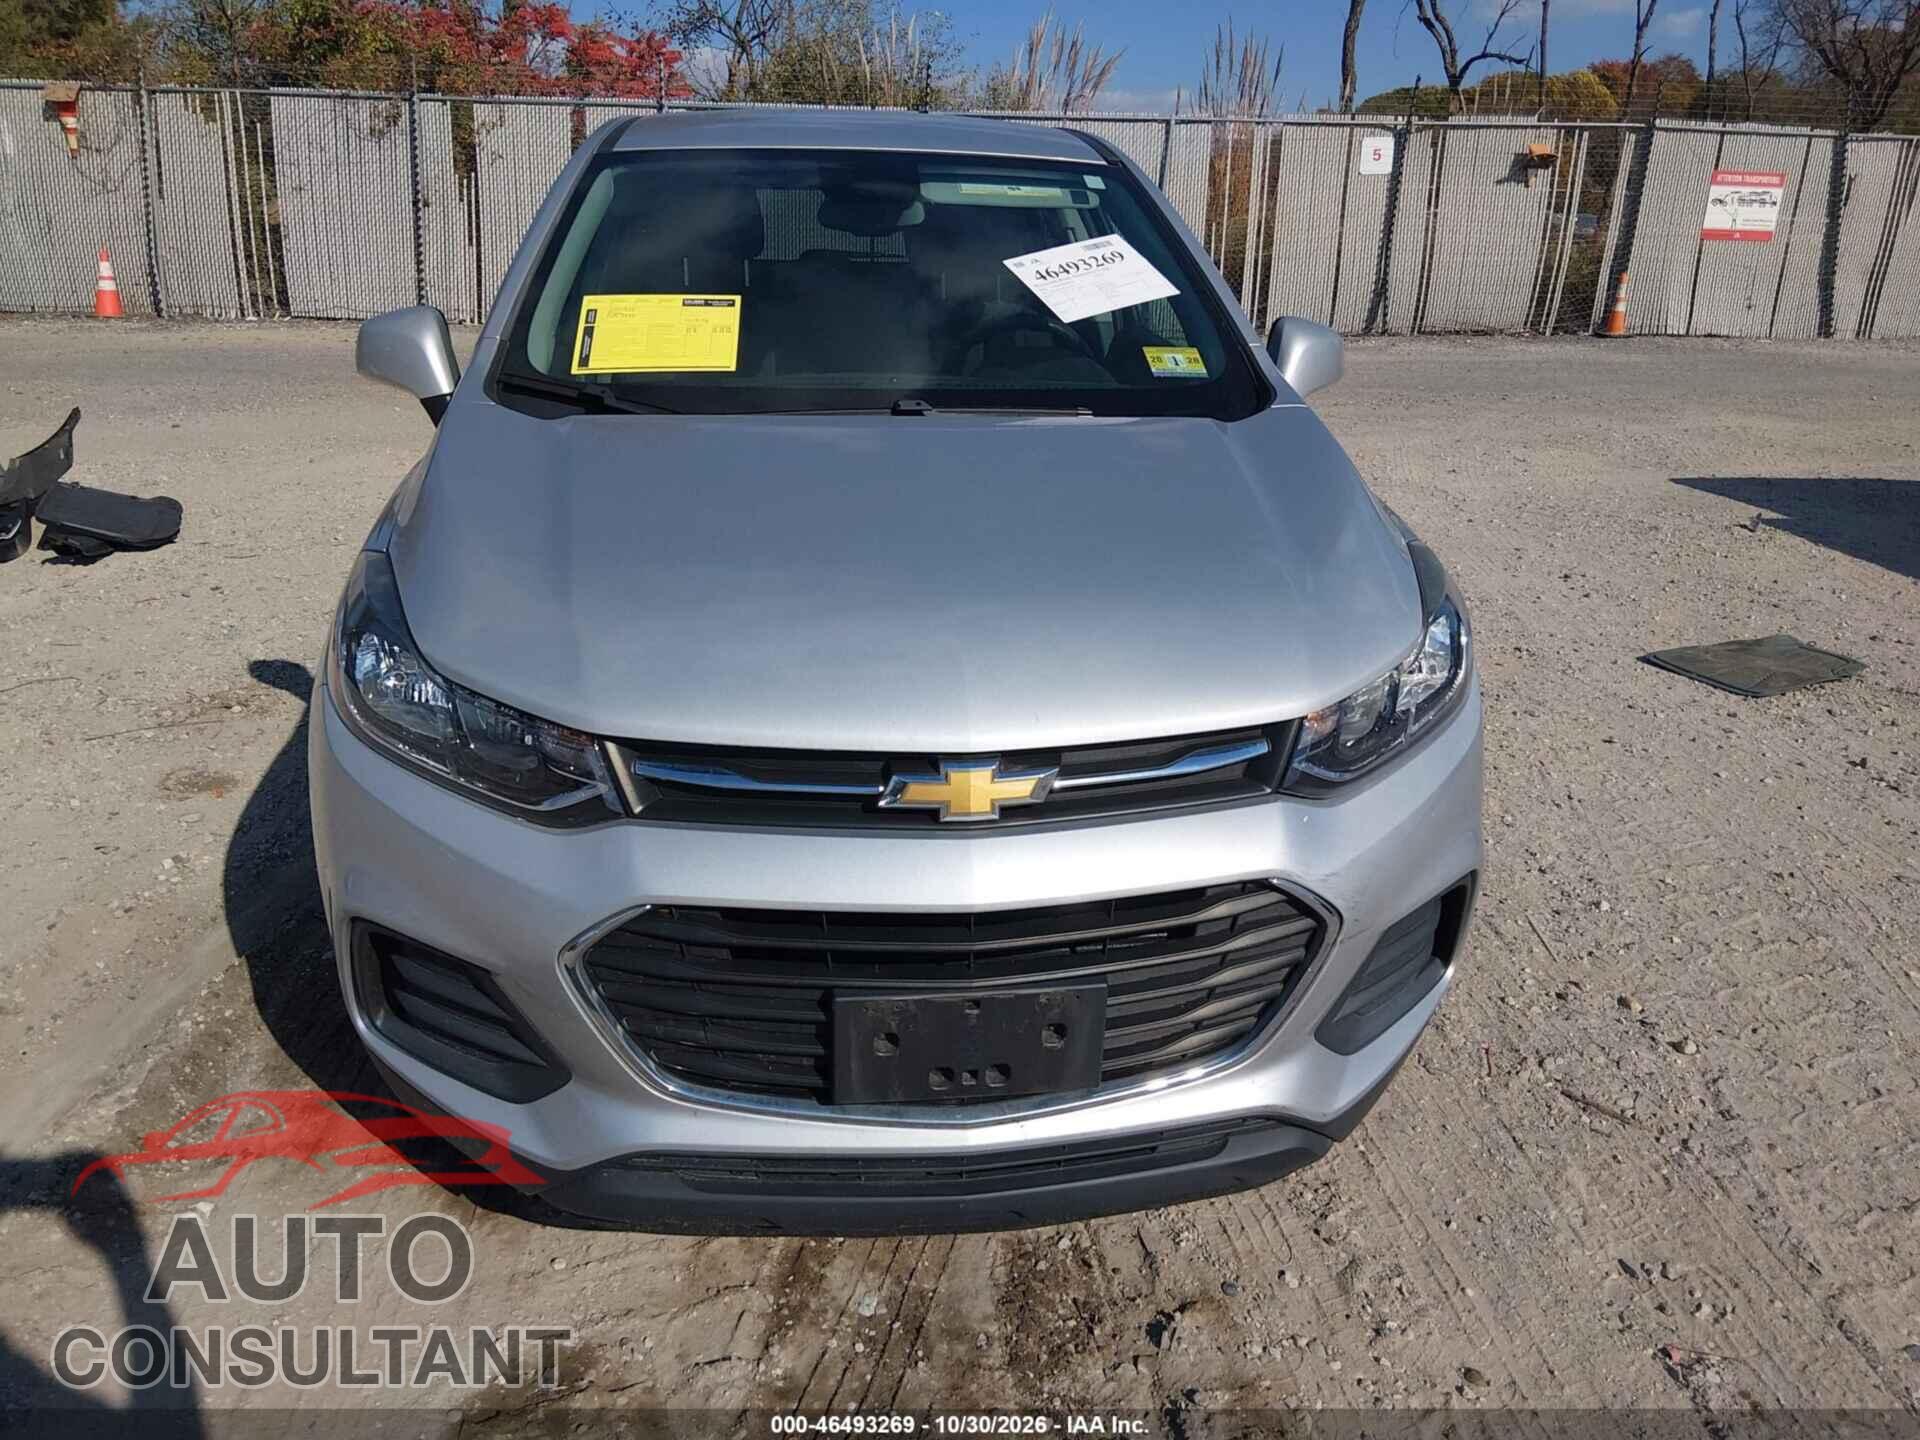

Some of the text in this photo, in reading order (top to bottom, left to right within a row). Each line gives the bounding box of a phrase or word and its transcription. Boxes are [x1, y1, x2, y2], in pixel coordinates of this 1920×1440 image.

[1372, 148, 1382, 161] 5
[1034, 250, 1125, 281] 46493269
[1172, 355, 1179, 367] 1
